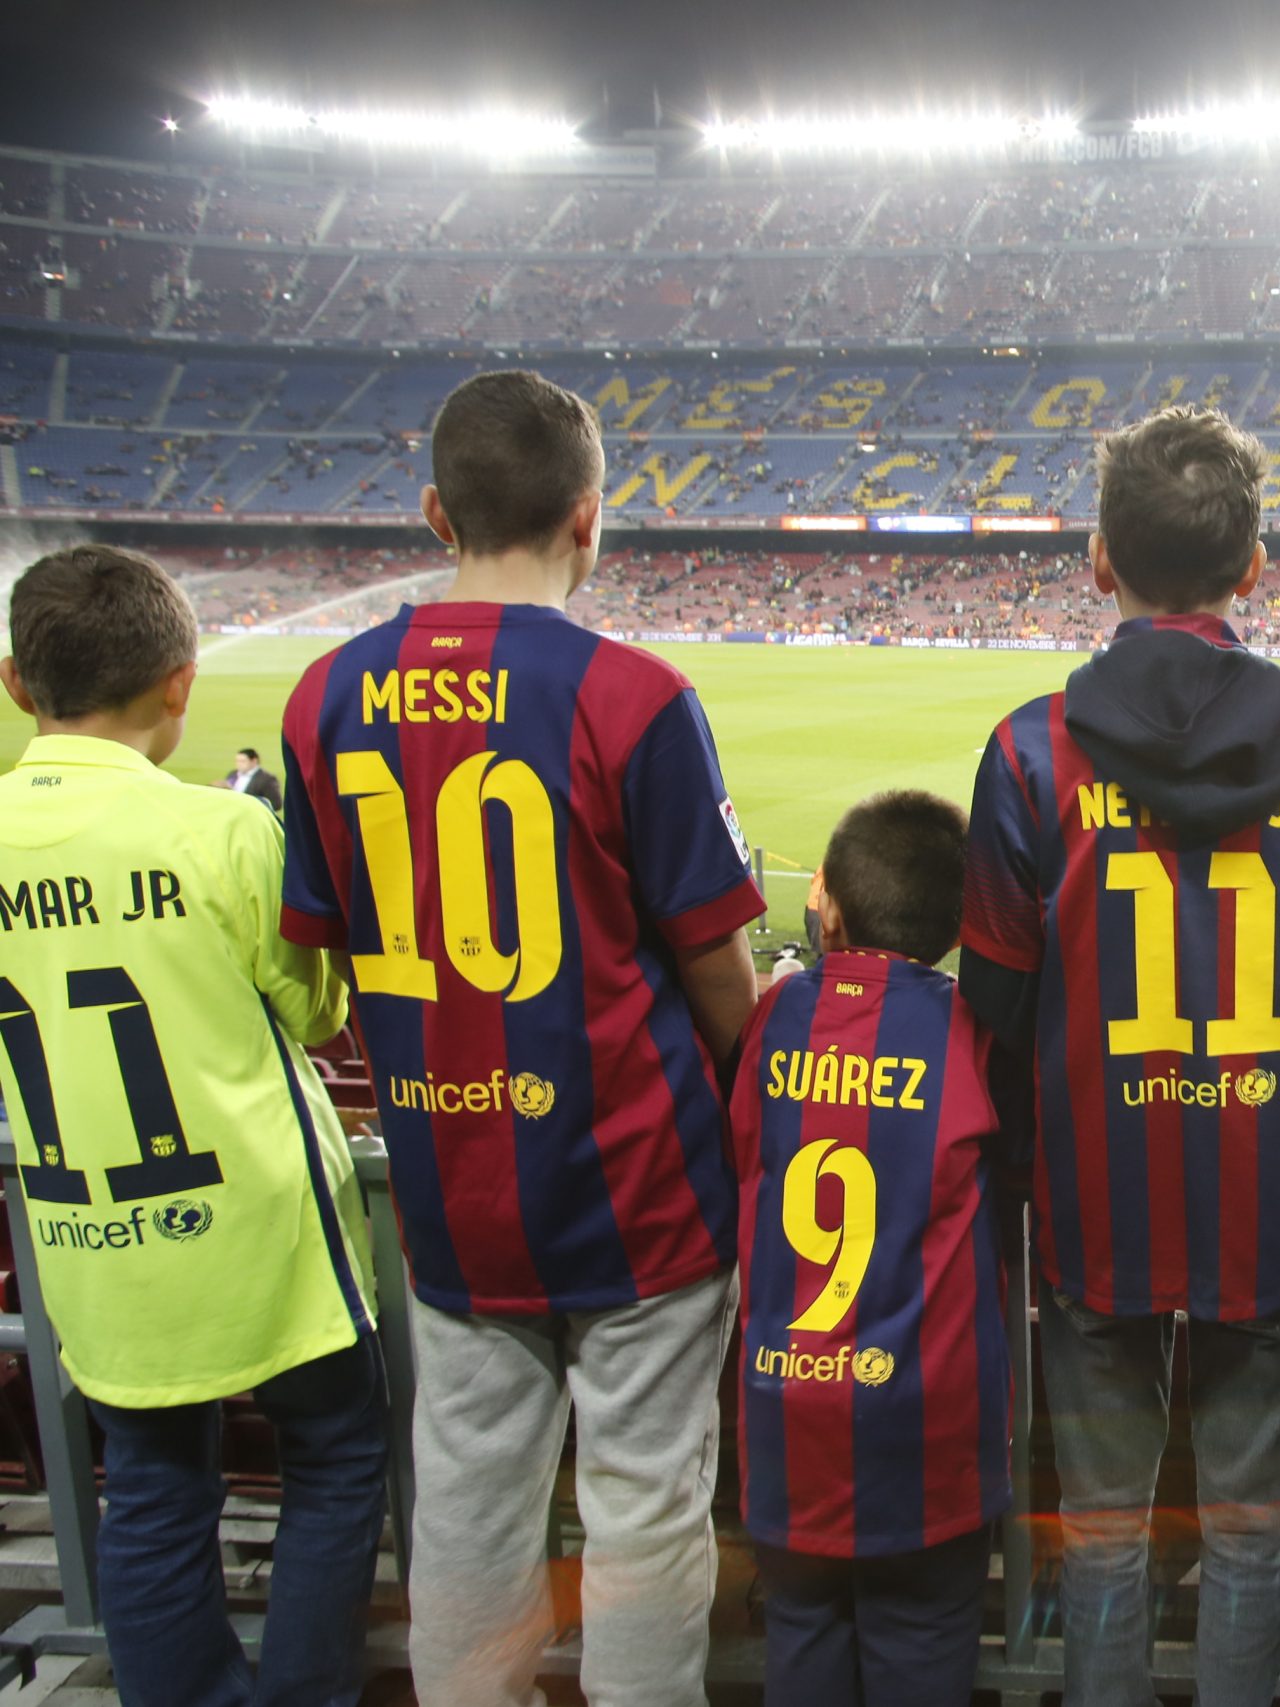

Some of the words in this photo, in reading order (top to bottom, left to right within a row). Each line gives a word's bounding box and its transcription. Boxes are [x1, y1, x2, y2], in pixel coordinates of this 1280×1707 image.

[431, 636, 463, 649] BARÇA
[362, 668, 509, 725] MESSI
[122, 868, 188, 922] JR
[336, 750, 563, 1003] 10
[835, 982, 864, 997] BARÇA
[0, 966, 225, 1205] 11
[391, 1069, 506, 1114] unicef
[766, 1045, 928, 1111] SUÁREZ
[1122, 1068, 1233, 1108] unicef
[38, 1206, 148, 1252] unicef
[782, 1138, 878, 1334] 9
[754, 1343, 852, 1383] unicef
